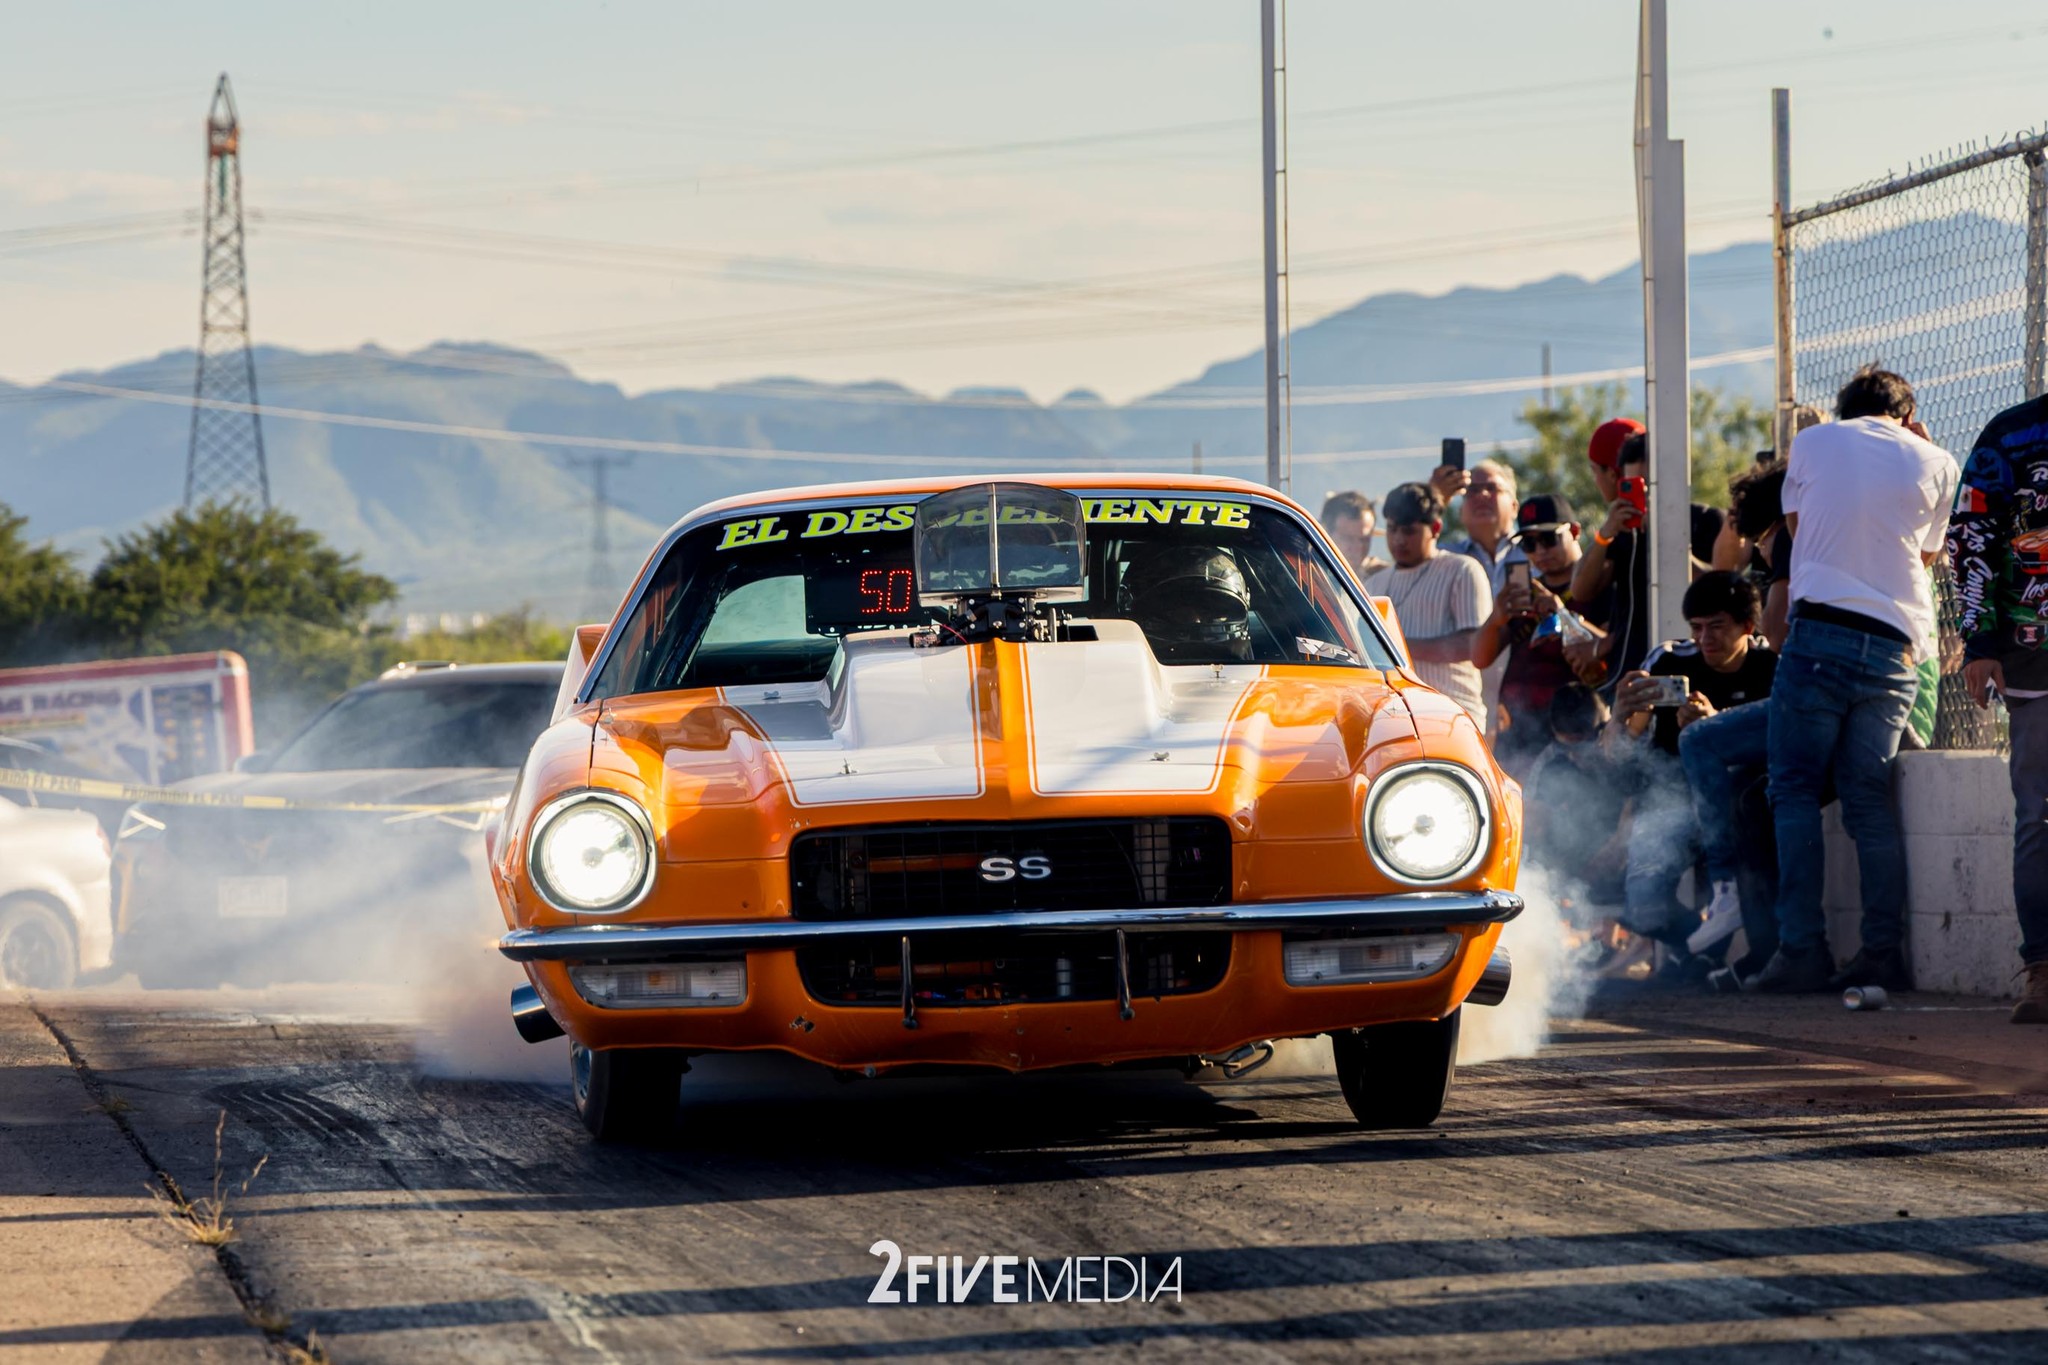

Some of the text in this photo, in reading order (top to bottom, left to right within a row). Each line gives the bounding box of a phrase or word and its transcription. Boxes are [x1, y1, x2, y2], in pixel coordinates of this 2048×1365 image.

[716, 517, 788, 551] EL
[861, 570, 912, 612] 50
[979, 856, 1052, 883] SS
